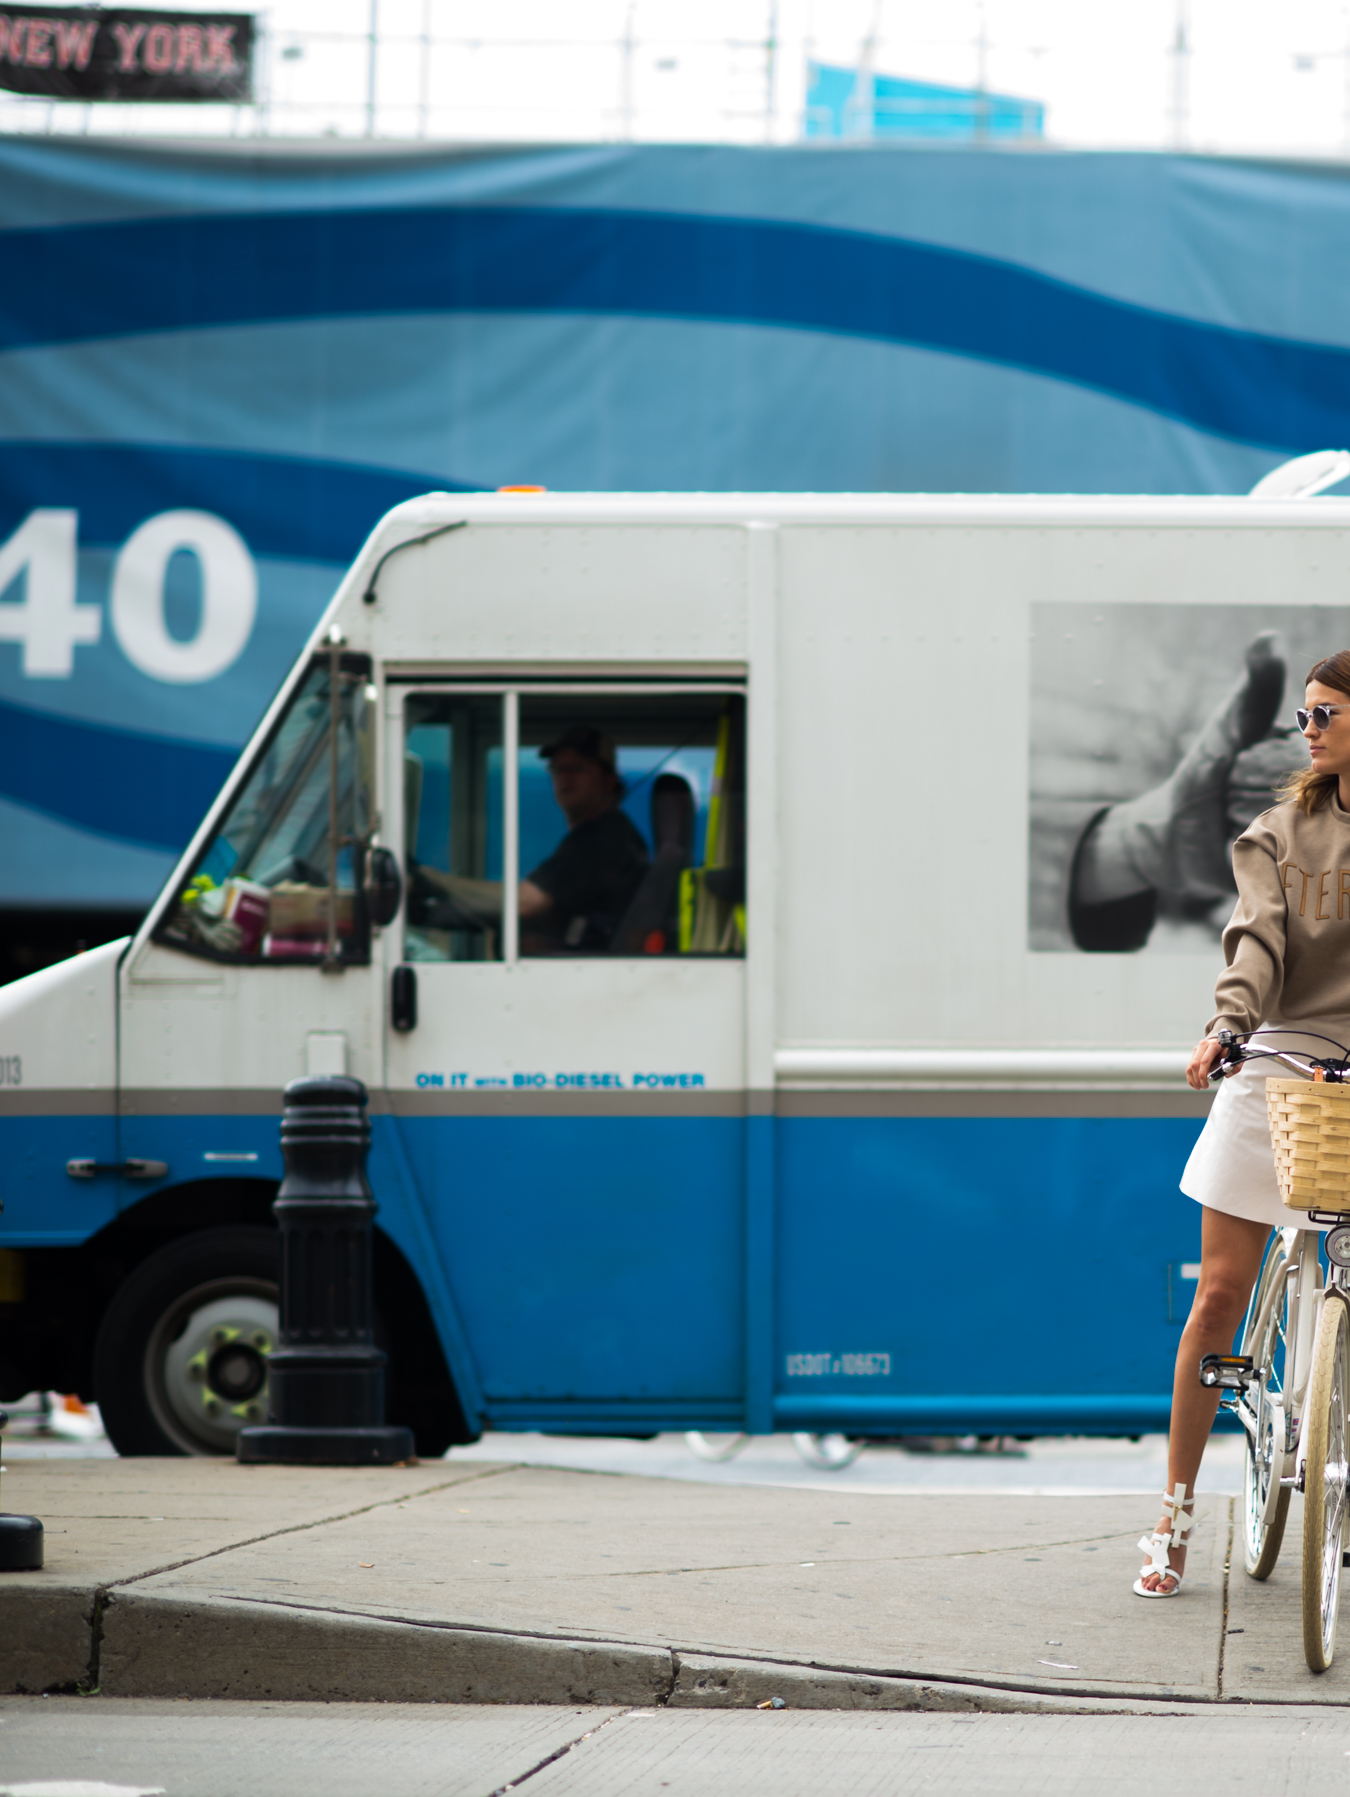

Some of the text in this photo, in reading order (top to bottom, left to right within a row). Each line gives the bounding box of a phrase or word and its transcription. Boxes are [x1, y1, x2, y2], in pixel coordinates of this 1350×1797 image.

[0, 14, 240, 74] NEW YORK
[0, 506, 258, 686] 40
[416, 1073, 444, 1088] ON
[451, 1073, 468, 1087] IT
[513, 1073, 625, 1088] BIO-DIESEL
[633, 1073, 705, 1087] POWER
